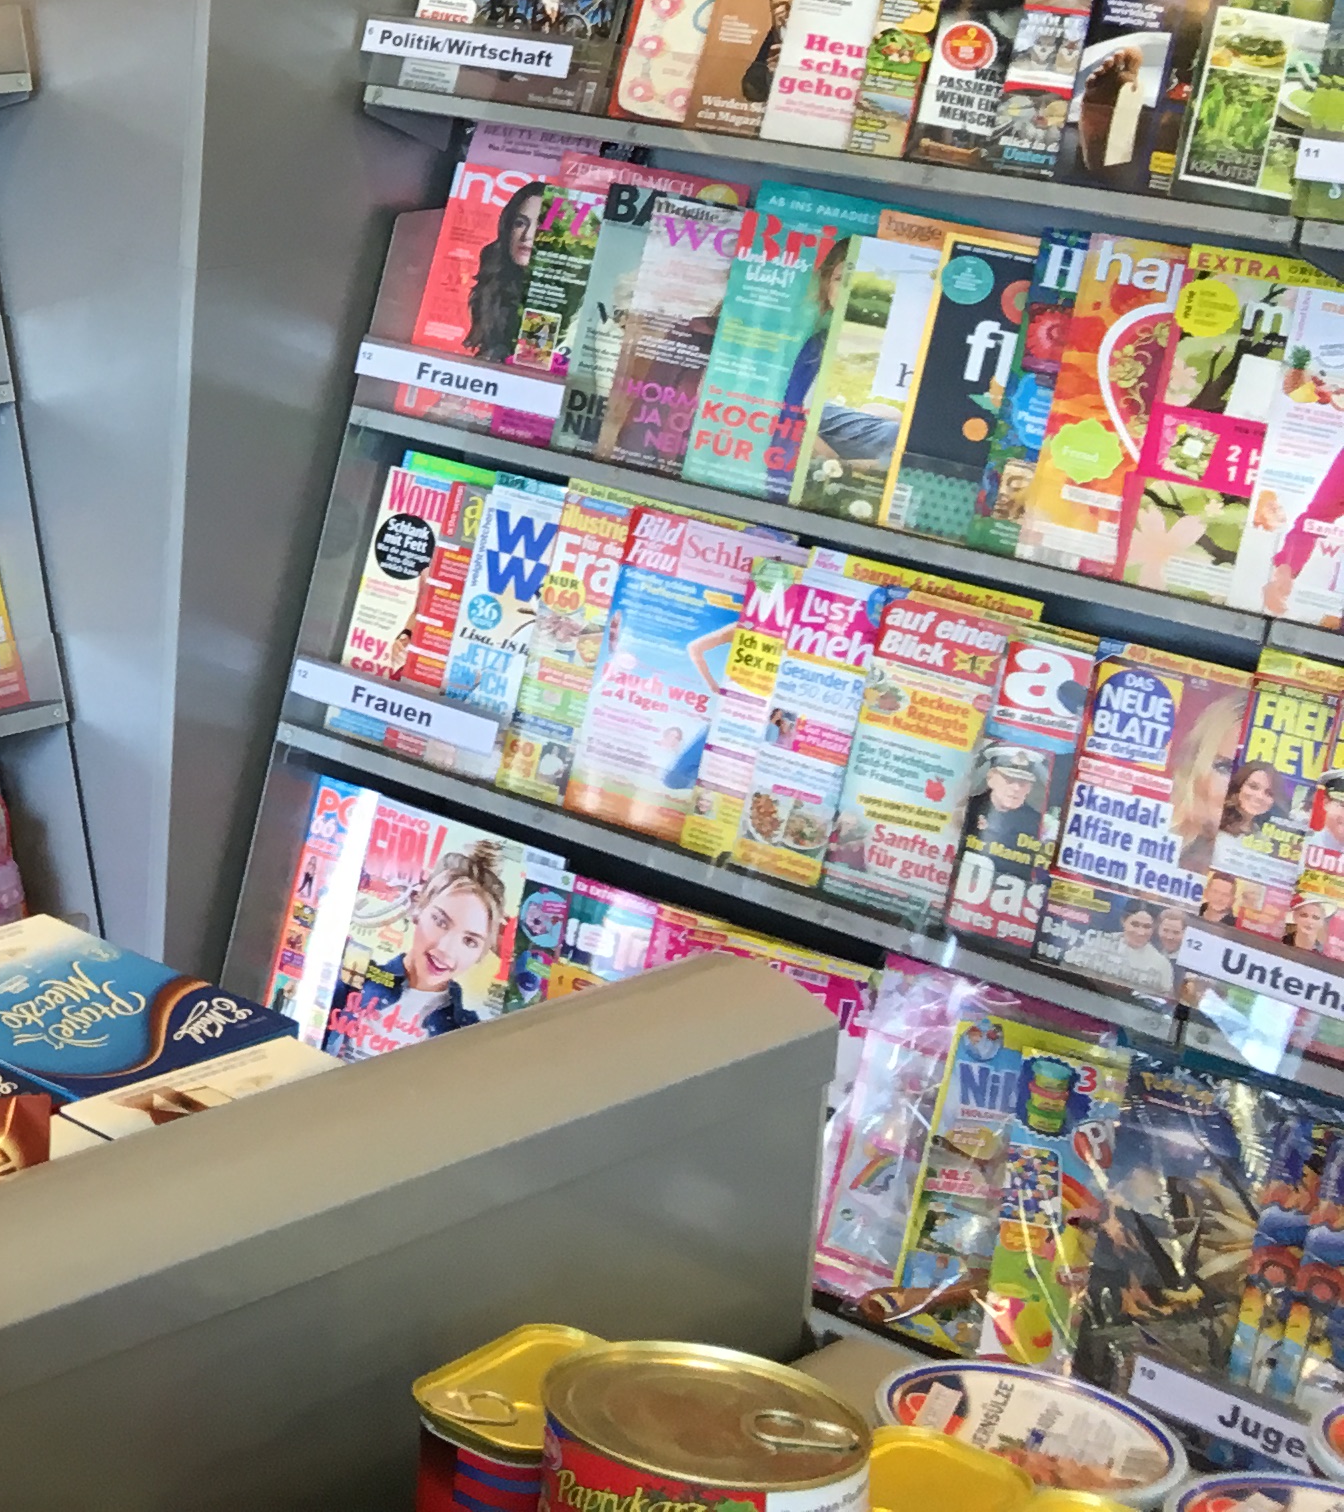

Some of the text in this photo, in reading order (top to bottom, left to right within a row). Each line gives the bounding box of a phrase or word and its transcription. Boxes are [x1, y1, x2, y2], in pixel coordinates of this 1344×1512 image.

[379, 29, 553, 68] Politik/Wirtschaft
[886, 213, 941, 241] hygge
[1197, 252, 1280, 279] EXTRA
[417, 363, 498, 397] Frauen
[695, 430, 752, 463] FÜR
[388, 518, 428, 539] Schlank
[637, 512, 681, 543] Bild
[629, 541, 677, 571] Frau
[550, 574, 579, 590] NUR
[801, 593, 858, 624] Lust
[885, 607, 1006, 650] auf einen
[881, 630, 949, 666] Blick
[1124, 672, 1155, 691] DAS
[351, 686, 431, 726] Frauen
[908, 707, 968, 734] Rezepte
[912, 692, 969, 718] Leckere
[996, 707, 1076, 731] die aktuelle
[1101, 685, 1171, 723] NEUE
[1094, 709, 1169, 750] BLATT
[378, 808, 431, 831] BRAVO
[1075, 785, 1165, 828] Skandal-
[872, 825, 939, 860] Sanfte
[1067, 813, 1175, 863] Affäre mit
[867, 845, 947, 885] für gute
[1062, 846, 1202, 901] einem Teenie
[1222, 947, 1344, 1012] Unterh
[1217, 1406, 1308, 1460] Juge
